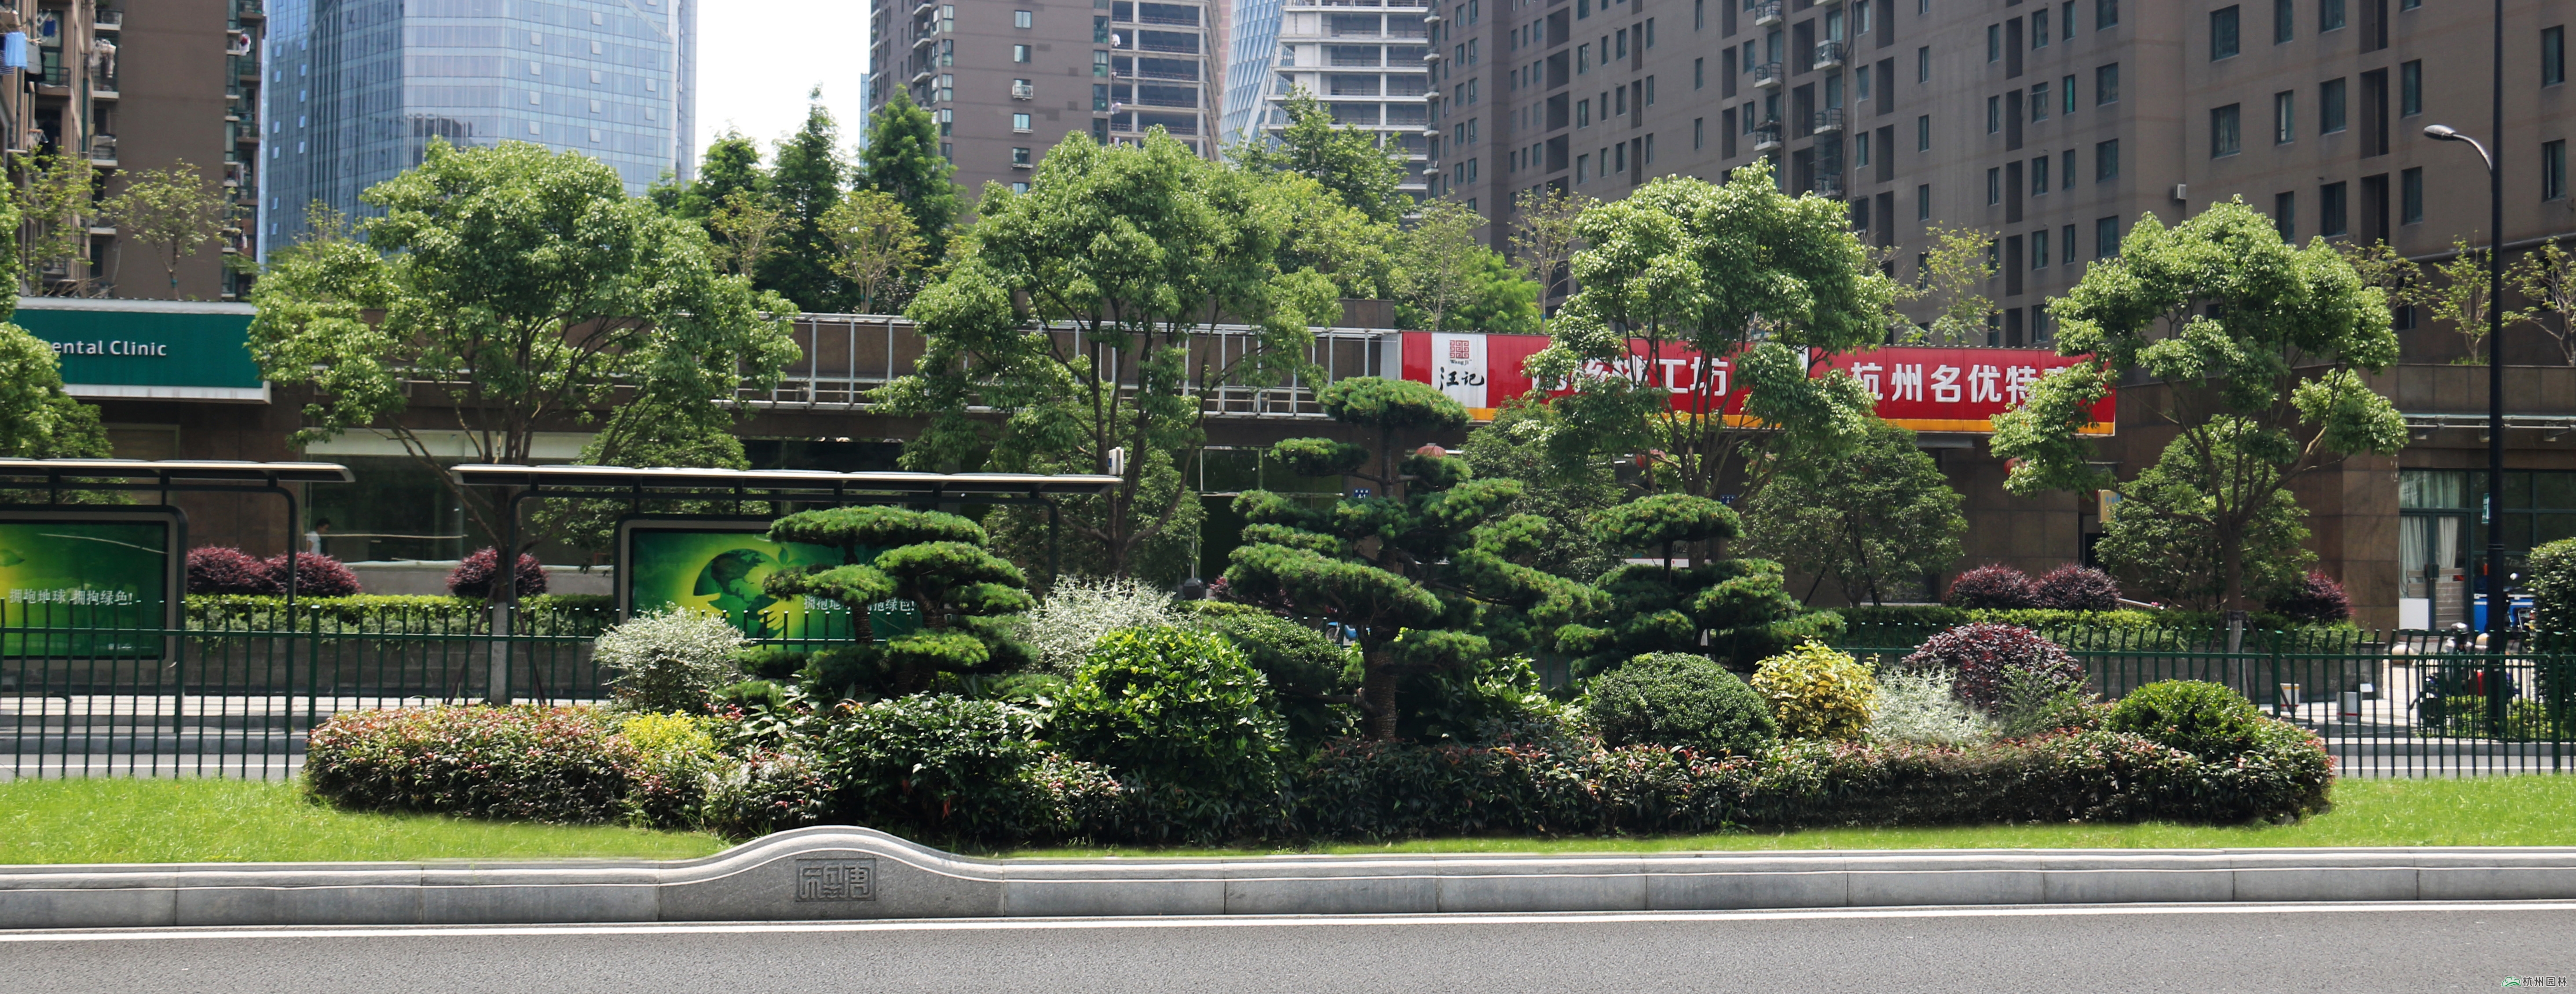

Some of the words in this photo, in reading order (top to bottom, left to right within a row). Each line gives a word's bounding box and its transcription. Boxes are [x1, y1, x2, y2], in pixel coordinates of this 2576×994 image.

[51, 340, 104, 354] ental
[110, 340, 167, 356] Clinic
[1439, 366, 1485, 391] 汪记
[1851, 362, 2068, 404] 杭州名优特
